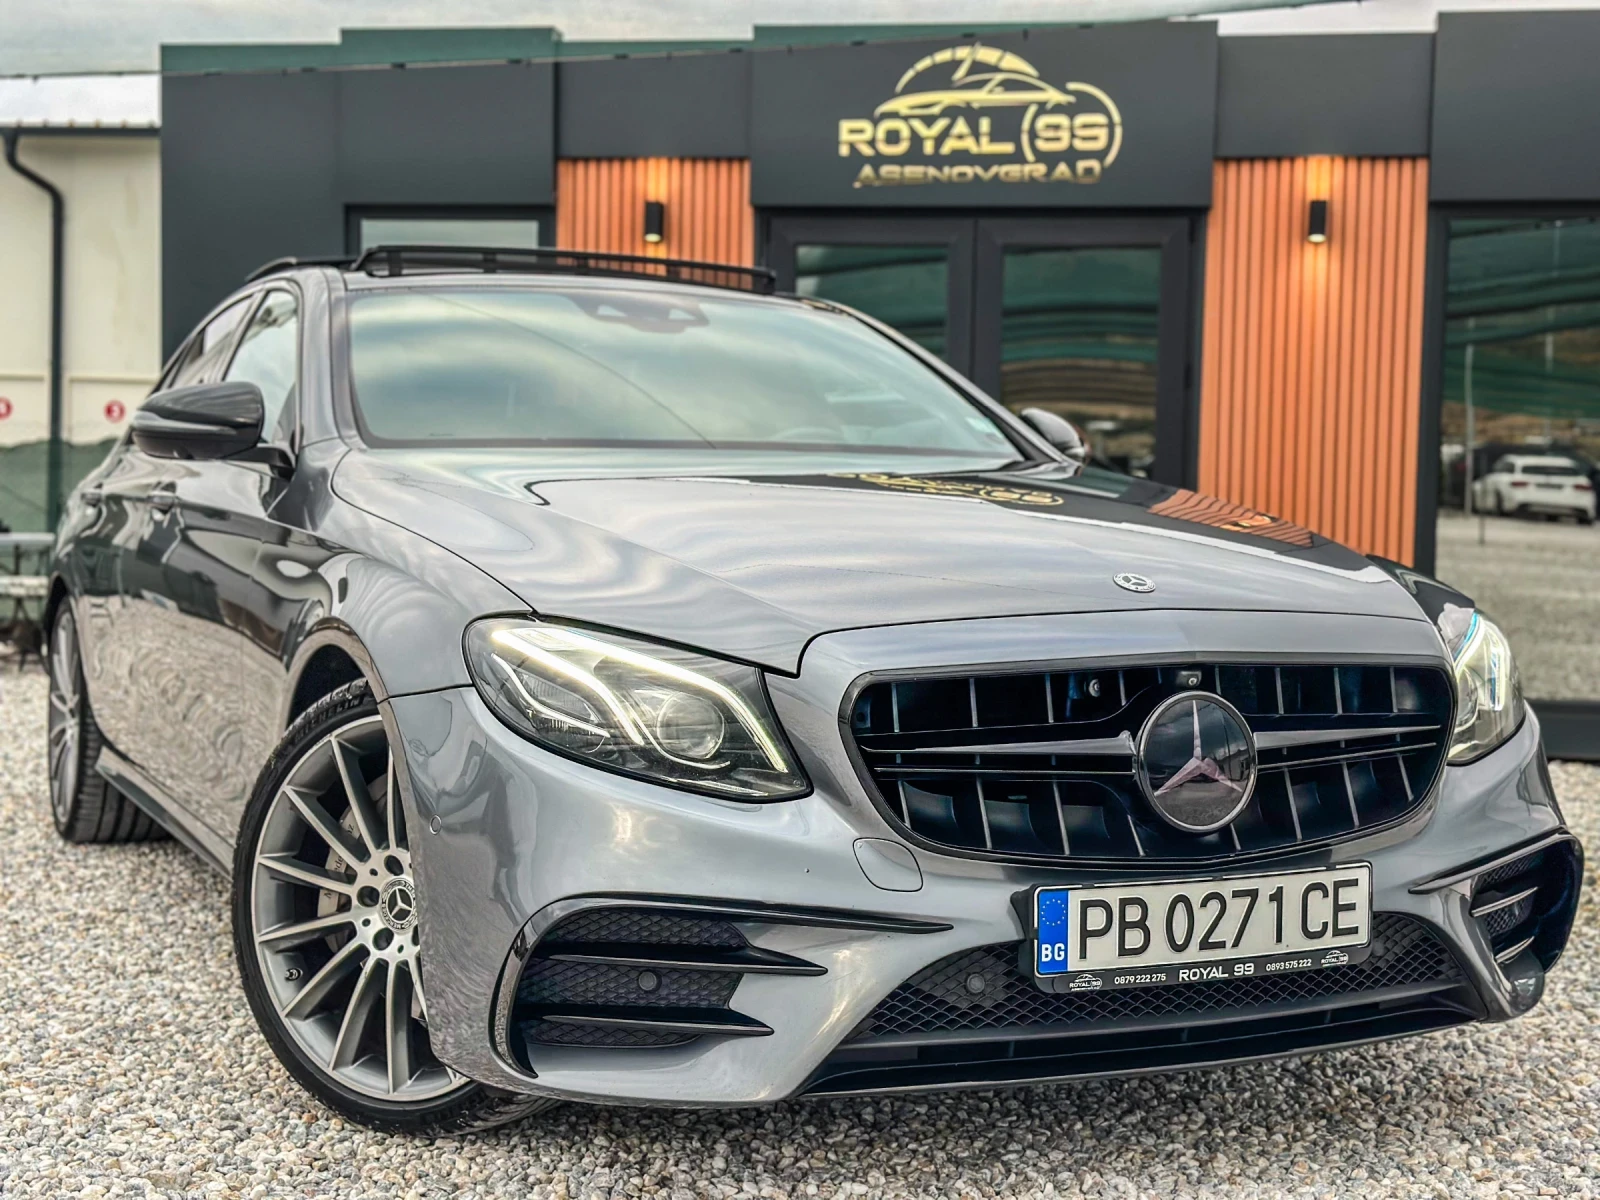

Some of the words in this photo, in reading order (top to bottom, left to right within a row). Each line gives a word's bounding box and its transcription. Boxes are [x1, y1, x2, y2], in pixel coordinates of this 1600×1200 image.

[839, 116, 1015, 156] ROYAL
[1035, 113, 1109, 152] 99
[857, 159, 1101, 184] ASENOVGRAD
[1078, 897, 1150, 960] PB
[1165, 885, 1284, 953] 0271
[1301, 878, 1359, 939] CE
[1041, 944, 1065, 962] BG
[1179, 965, 1228, 982] ROYAL
[1233, 963, 1255, 976] 99
